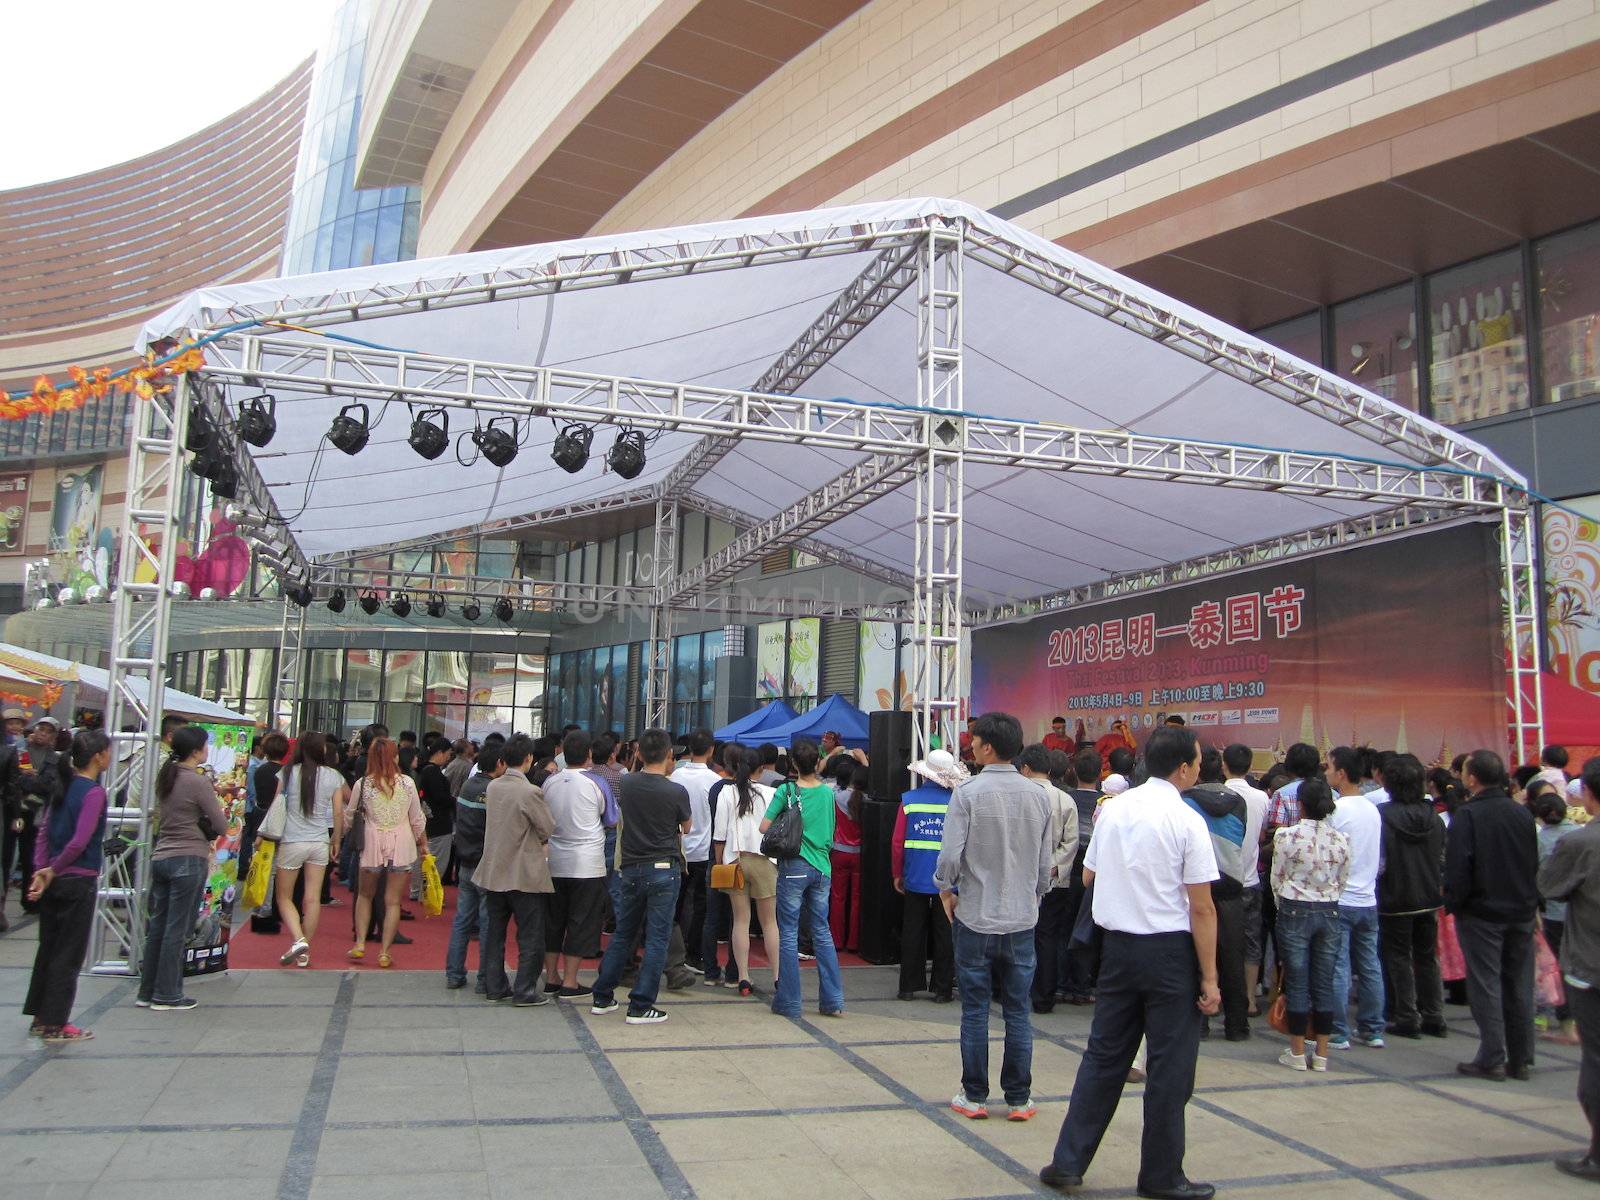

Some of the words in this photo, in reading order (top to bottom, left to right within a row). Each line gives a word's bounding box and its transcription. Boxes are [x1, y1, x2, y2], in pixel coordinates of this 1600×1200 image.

[1067, 670, 1093, 689] Thai
[1095, 662, 1145, 686] Festival
[1190, 652, 1271, 677] Kunming
